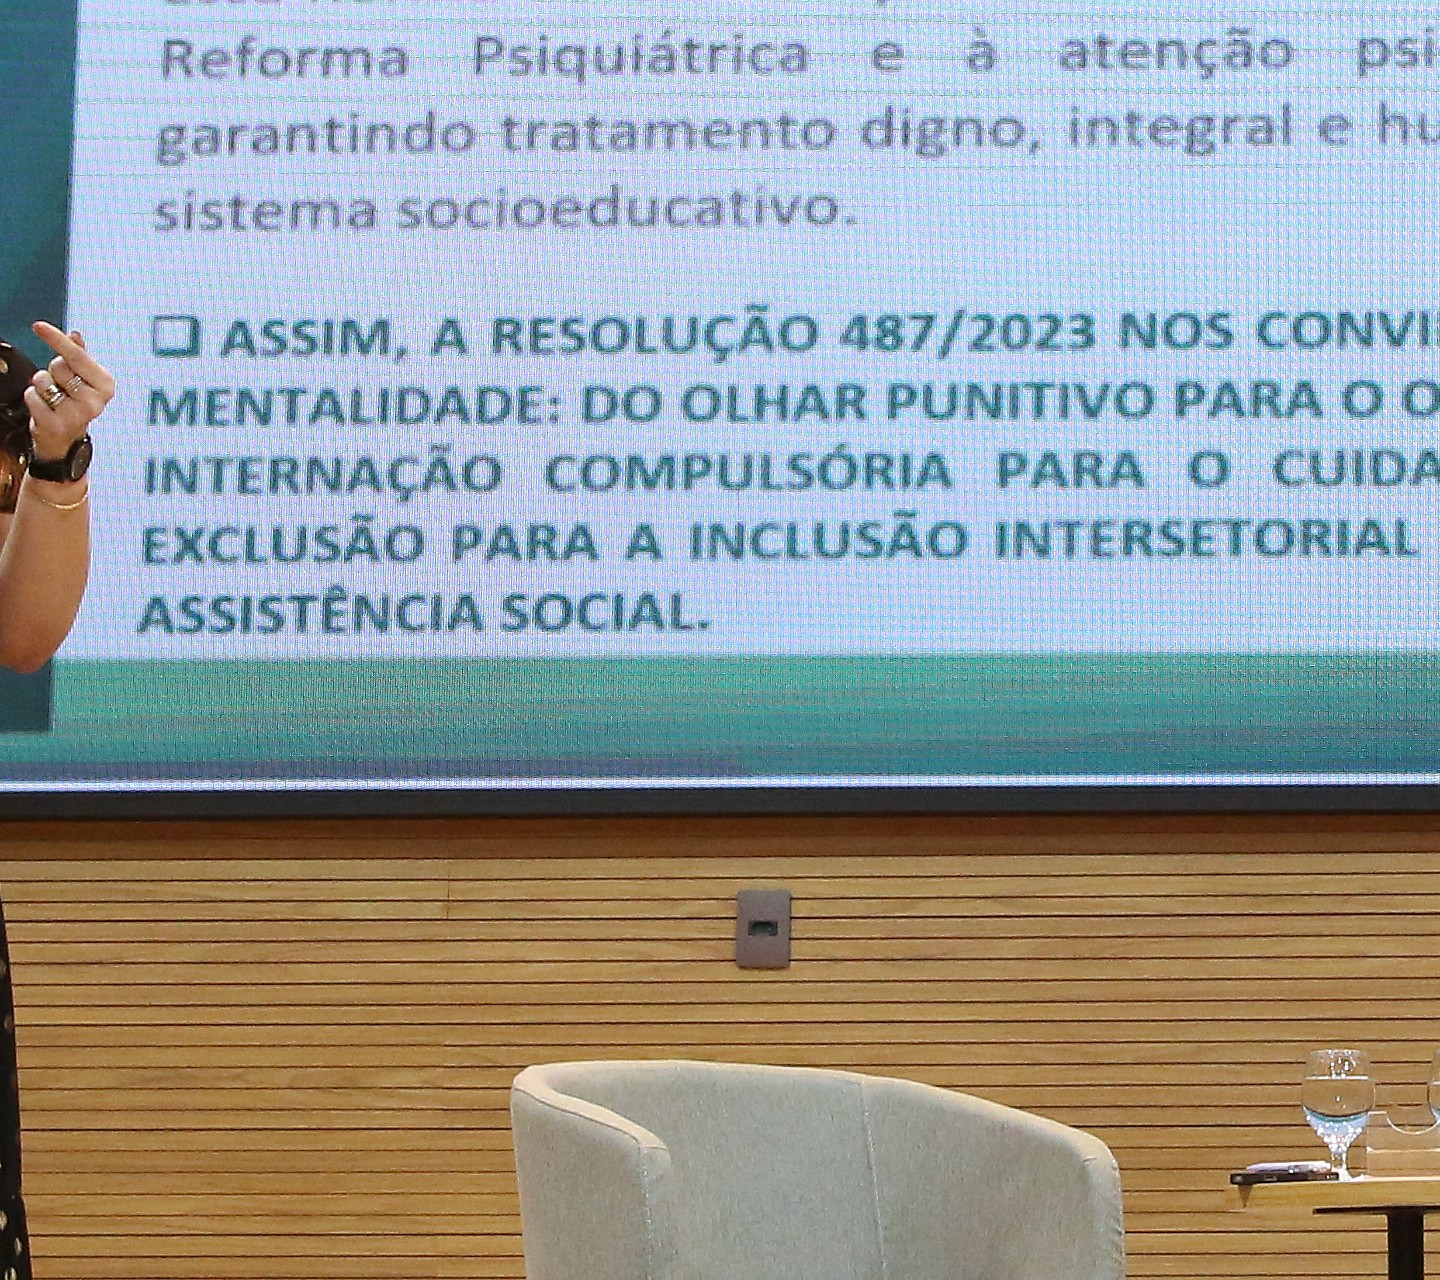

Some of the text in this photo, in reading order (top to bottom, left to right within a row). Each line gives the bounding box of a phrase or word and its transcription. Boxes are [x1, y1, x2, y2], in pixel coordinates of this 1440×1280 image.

[160, 34, 410, 79] Reforma
[472, 29, 810, 84] Psiquiátrica
[870, 41, 904, 72] e
[965, 26, 997, 72] à
[1059, 26, 1295, 80] atenção
[155, 110, 477, 167] garantindo
[501, 113, 837, 152] tratamento
[860, 105, 1040, 159] digno,
[1069, 103, 1292, 157] integral
[1317, 114, 1352, 145] e
[155, 184, 857, 232] sistema socioeducativo.
[220, 317, 408, 362] ASSIM,
[430, 317, 469, 356] A
[491, 302, 820, 364] RESOLUÇÃO
[839, 308, 1096, 360] 487/2023
[1119, 311, 1235, 351] NOS
[147, 385, 560, 427] MENTALIDADE:
[581, 384, 663, 424] DO
[680, 382, 867, 423] OLHAR
[886, 380, 1157, 421] PUNITIVO
[1174, 379, 1324, 419] PARA
[1341, 379, 1384, 419] O
[144, 444, 504, 504] INTERNAÇÃO
[544, 443, 954, 493] COMPULSÓRIA
[996, 450, 1146, 489] PARA
[1187, 449, 1231, 489] O
[141, 513, 426, 566] EXCLUSÃO
[451, 522, 600, 563] PARA
[624, 522, 663, 561] A
[690, 509, 970, 561] INCLUSÃO
[995, 518, 1418, 560] INTERSETORIAL
[136, 584, 710, 635] ASSISTÊNCIA SOCIAL.
